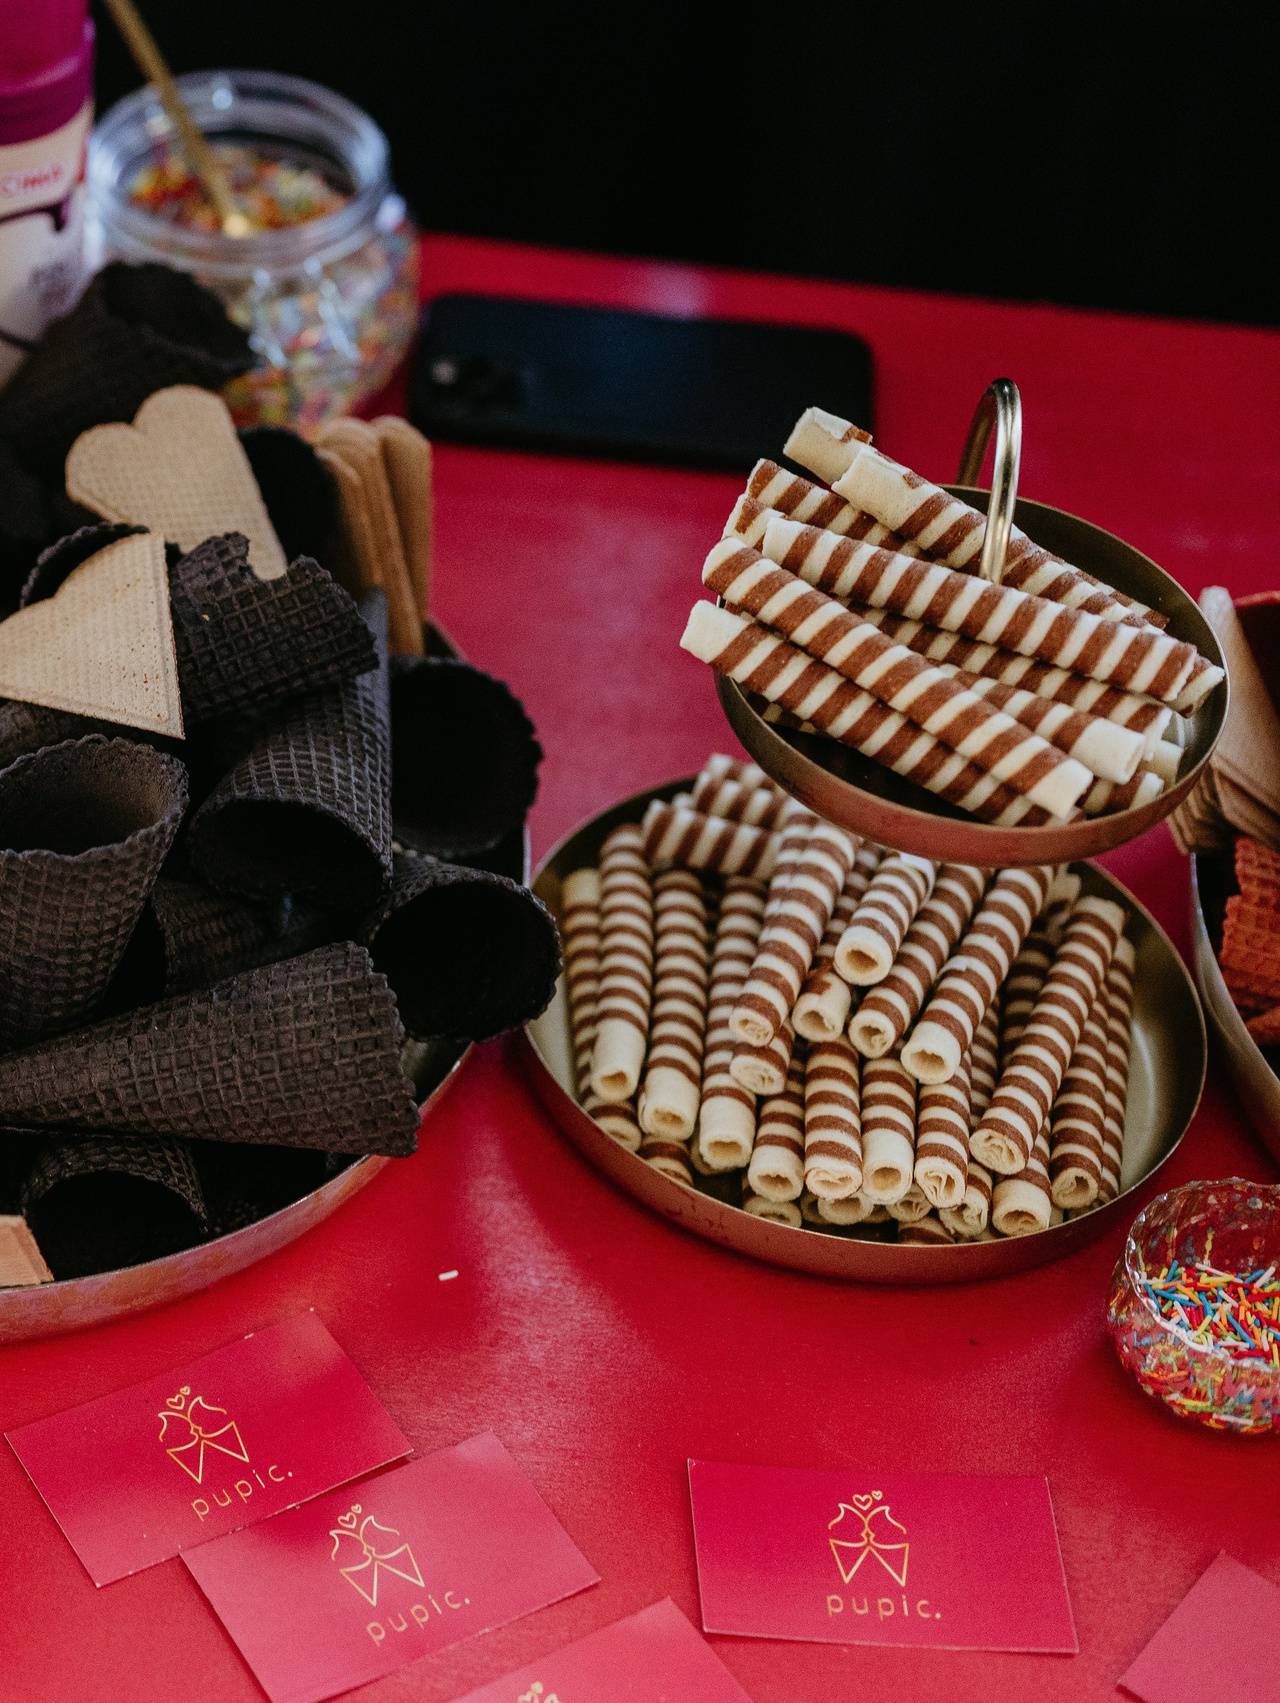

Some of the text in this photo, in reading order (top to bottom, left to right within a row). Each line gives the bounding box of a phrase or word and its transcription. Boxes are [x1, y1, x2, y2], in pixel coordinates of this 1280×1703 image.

[190, 1463, 293, 1521] pupic.
[365, 1590, 470, 1646] pupic.
[826, 1594, 941, 1622] pupic.
